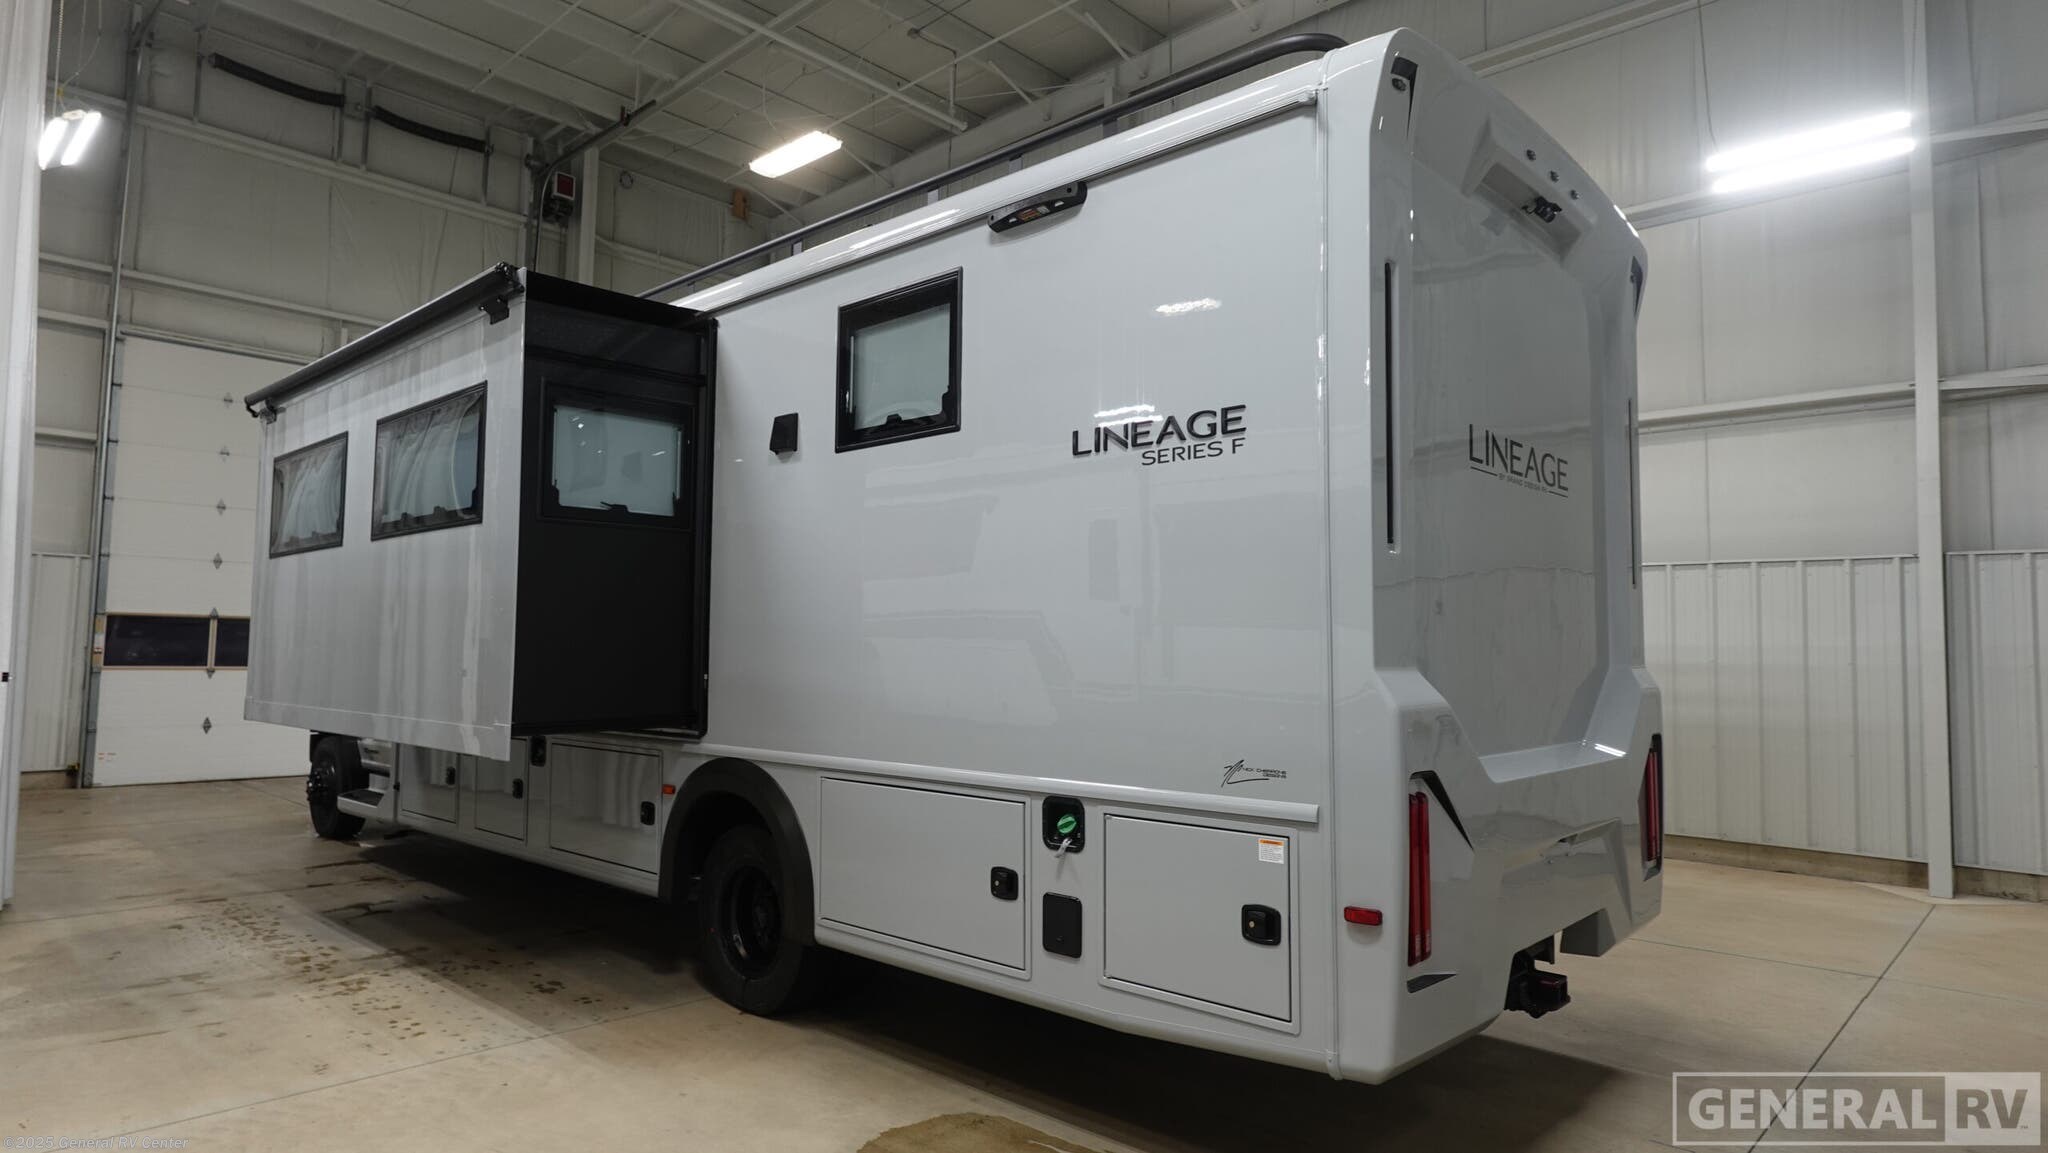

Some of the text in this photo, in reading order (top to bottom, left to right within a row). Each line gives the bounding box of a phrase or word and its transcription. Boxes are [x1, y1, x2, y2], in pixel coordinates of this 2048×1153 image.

[1072, 404, 1247, 456] LINEAGE
[1141, 437, 1246, 466] SERIES F
[1468, 423, 1569, 492] LINEAGE
